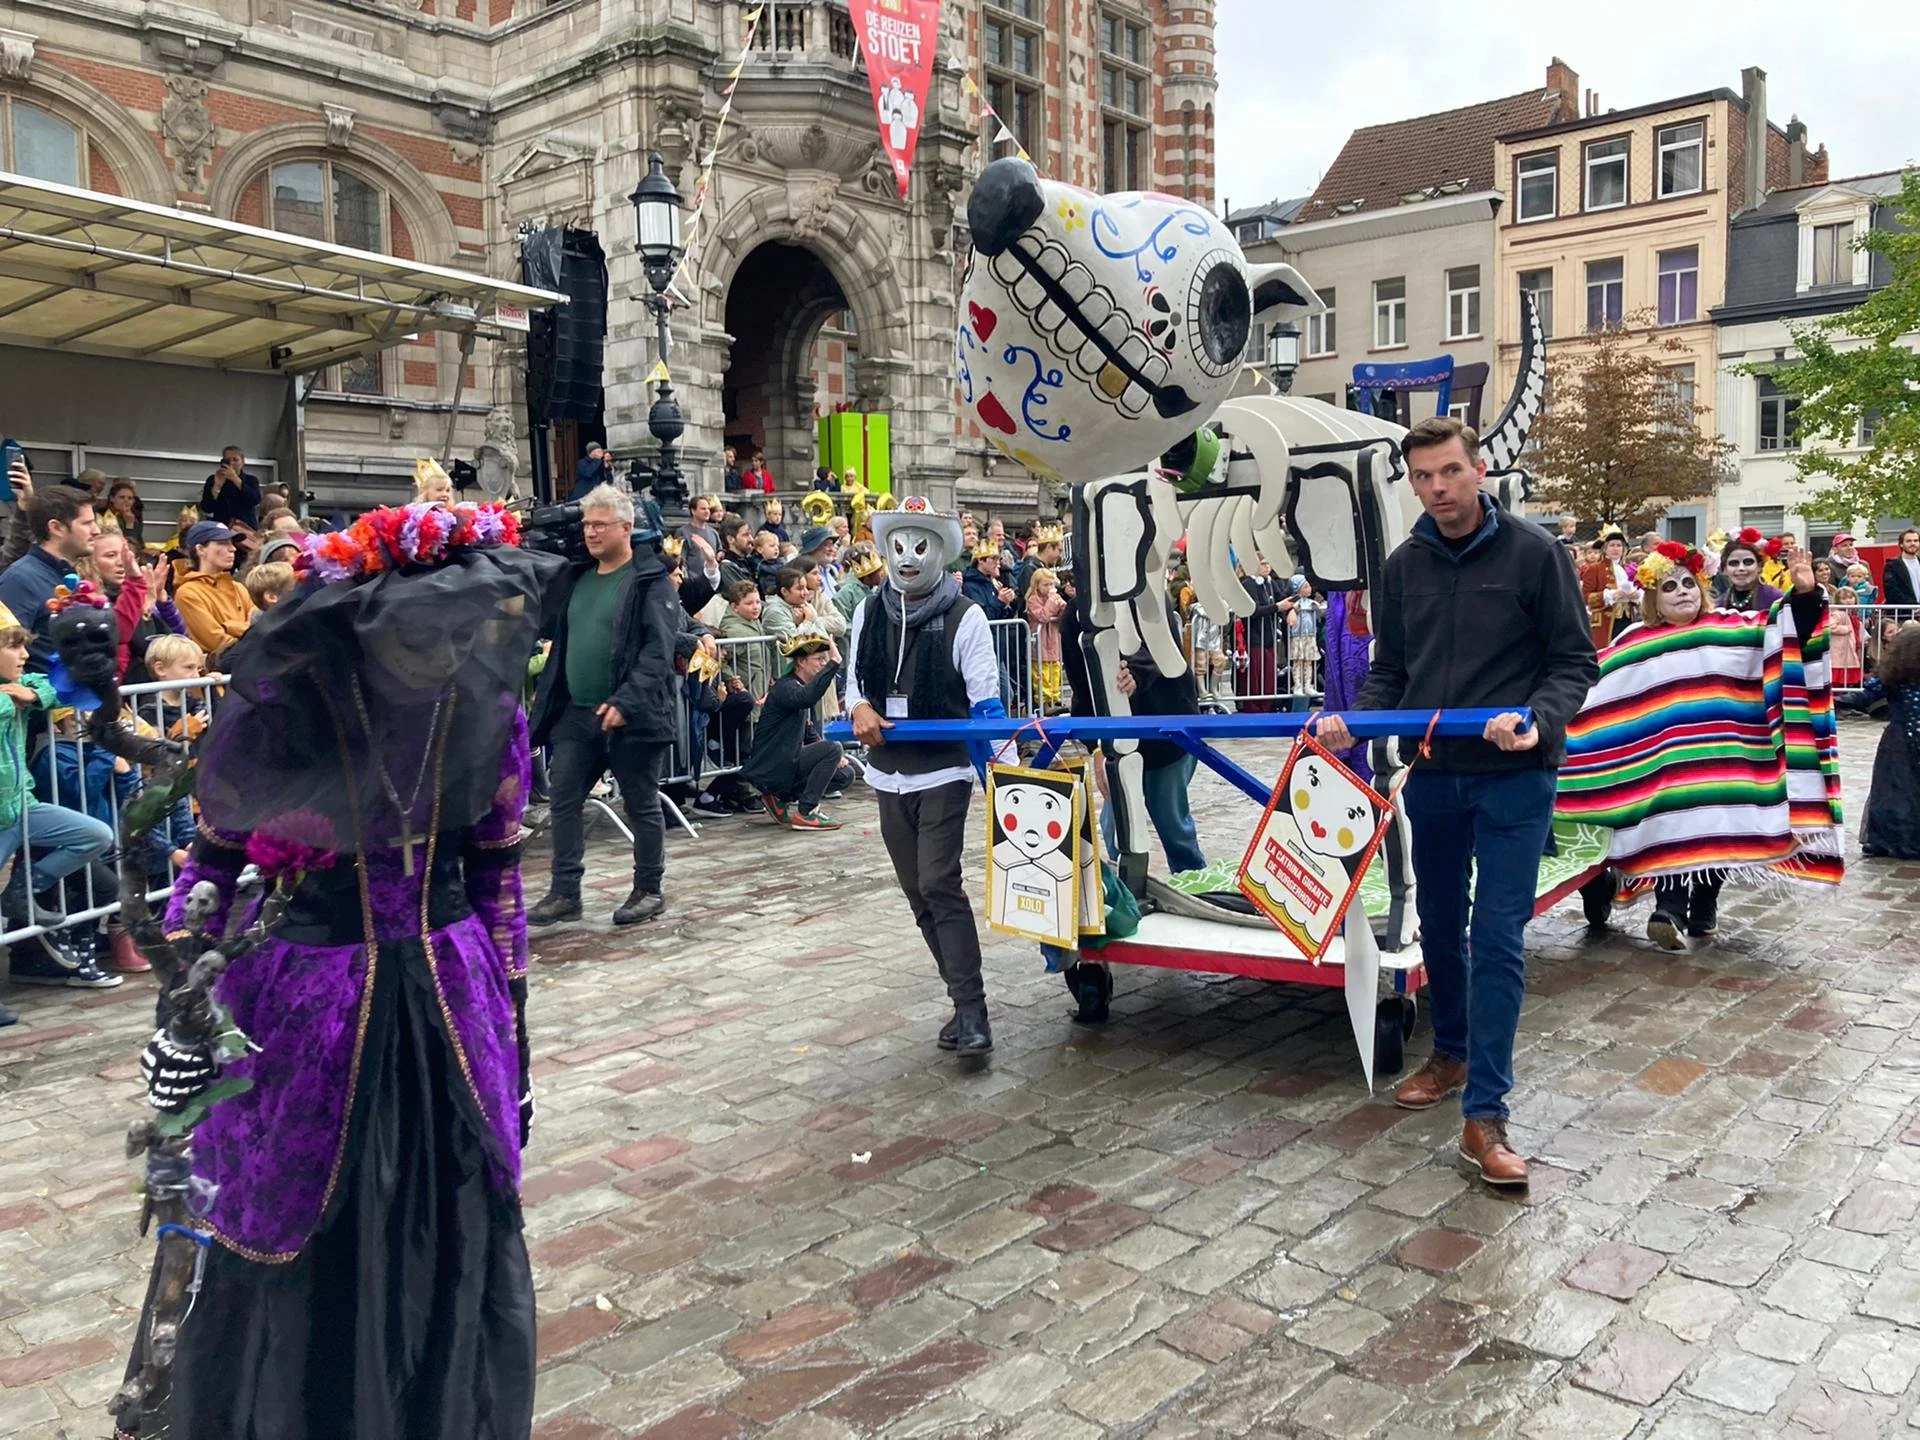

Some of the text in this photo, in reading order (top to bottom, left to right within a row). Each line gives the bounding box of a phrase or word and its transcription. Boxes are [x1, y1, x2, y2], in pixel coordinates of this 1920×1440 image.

[865, 9, 921, 40] DE REUZEN
[867, 26, 921, 64] STOET
[1266, 841, 1277, 855] LA
[1275, 850, 1303, 880] CATRINA
[1301, 875, 1330, 906] GIGANTE
[1267, 860, 1279, 874] DE
[1020, 896, 1043, 913] XOLO
